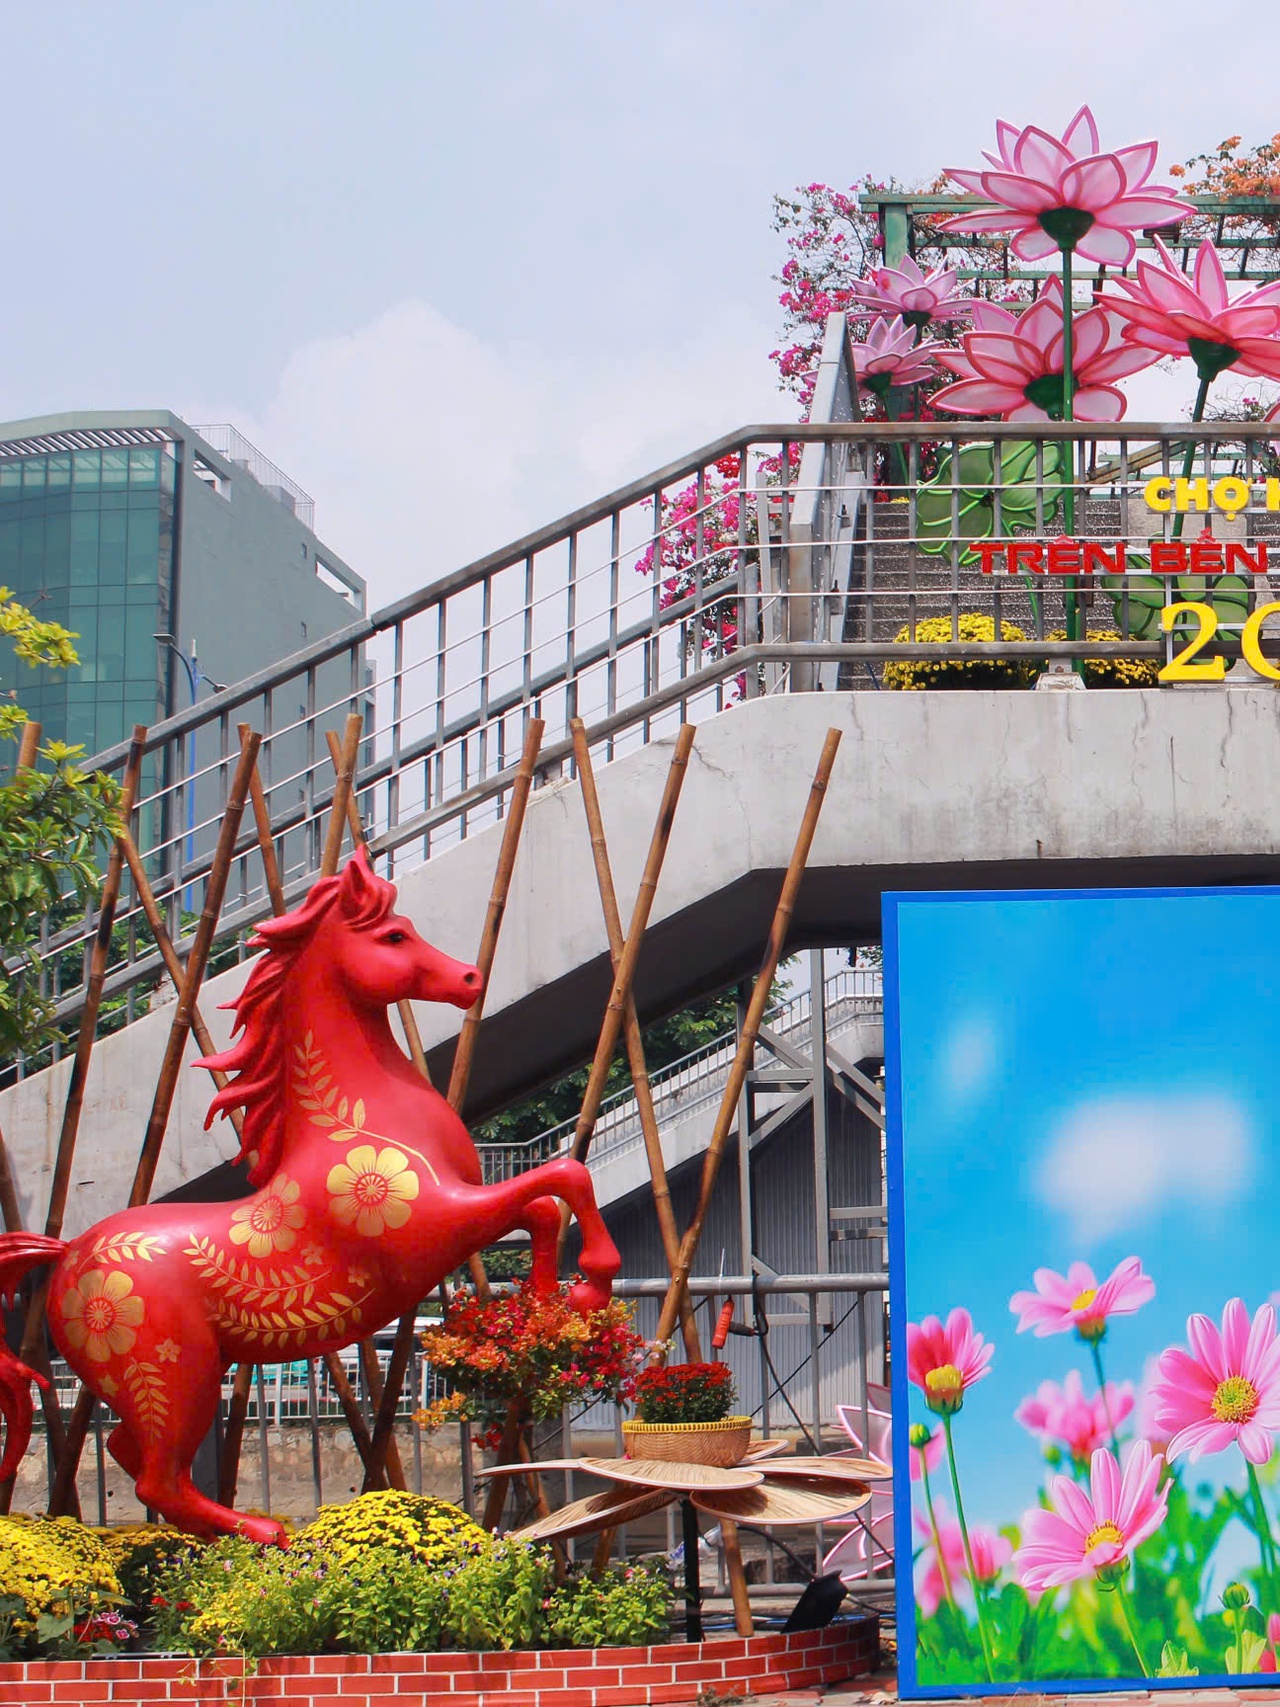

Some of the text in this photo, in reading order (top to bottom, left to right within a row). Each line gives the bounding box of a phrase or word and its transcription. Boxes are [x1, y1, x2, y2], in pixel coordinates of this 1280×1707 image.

[1143, 477, 1253, 522] CHỢ
[969, 534, 1126, 575] TRÊN
[1150, 527, 1268, 574] BẾN
